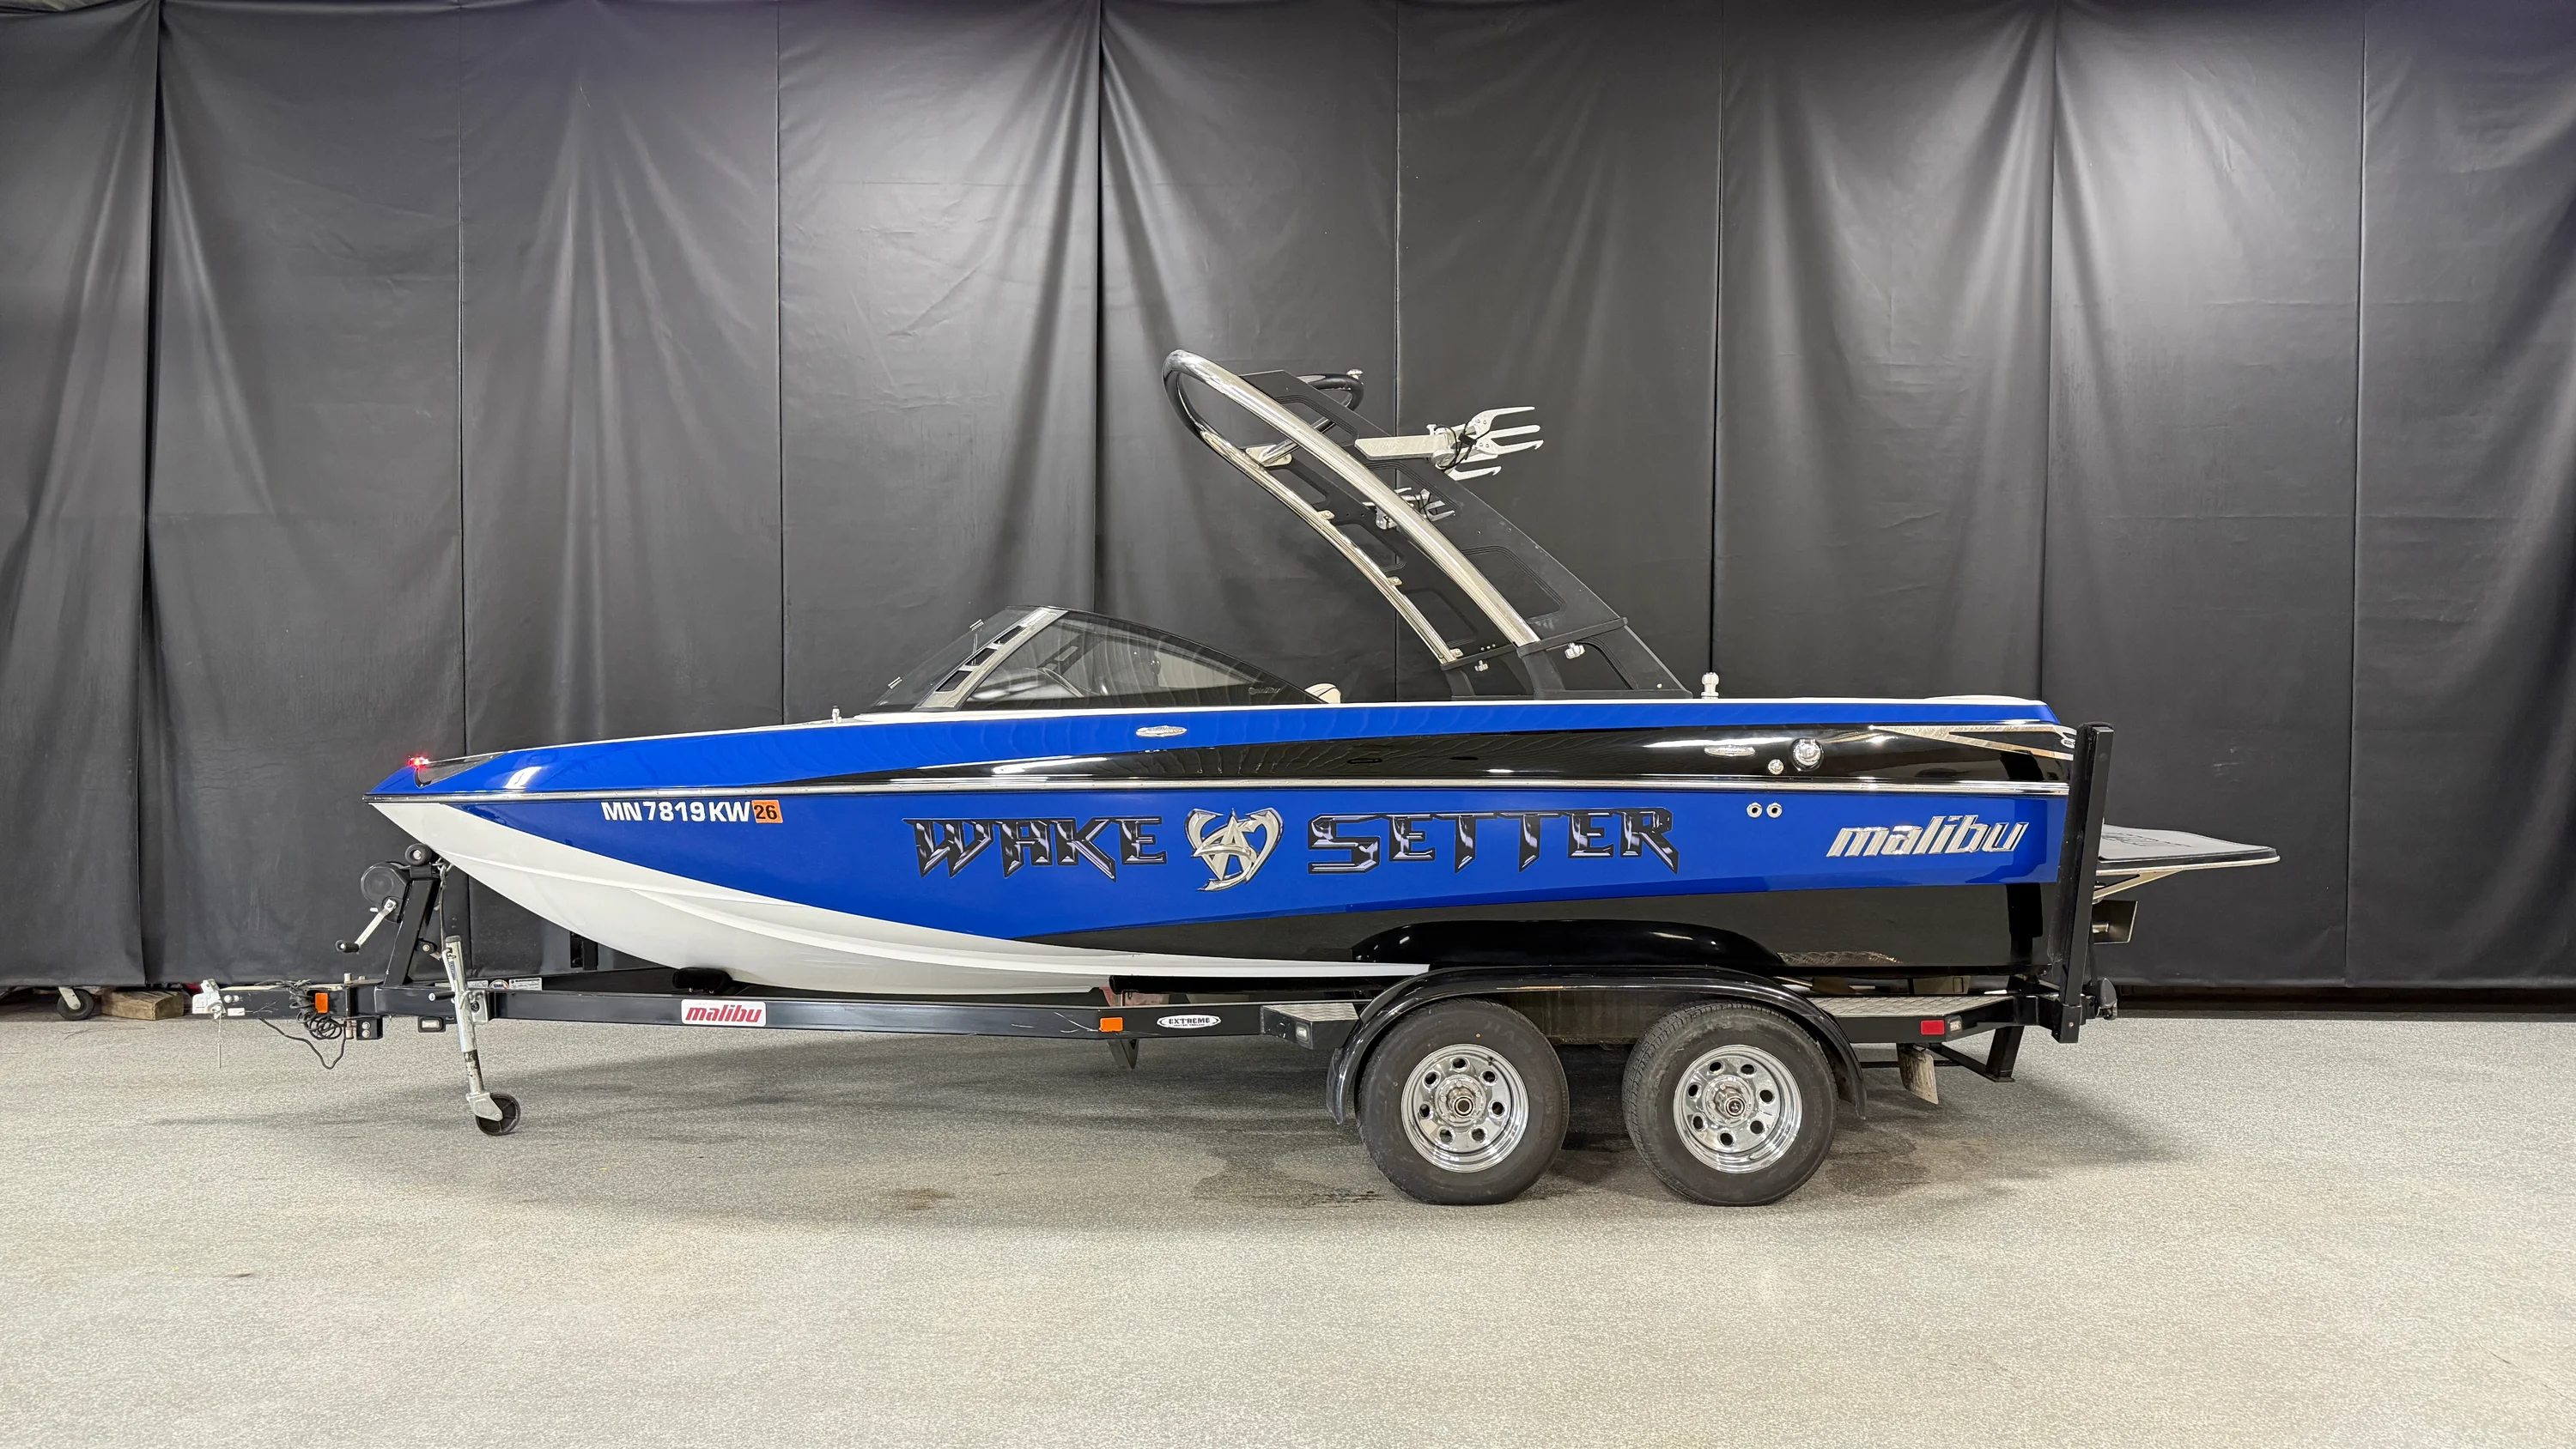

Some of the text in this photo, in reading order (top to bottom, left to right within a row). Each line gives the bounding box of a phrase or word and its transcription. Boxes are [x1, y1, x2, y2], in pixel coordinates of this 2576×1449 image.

[601, 801, 750, 822] MN 7819 KW
[753, 804, 778, 820] 26
[902, 806, 1680, 882] WAKE SETTER
[1826, 814, 2030, 858] malibu
[685, 1004, 762, 1023] malibu
